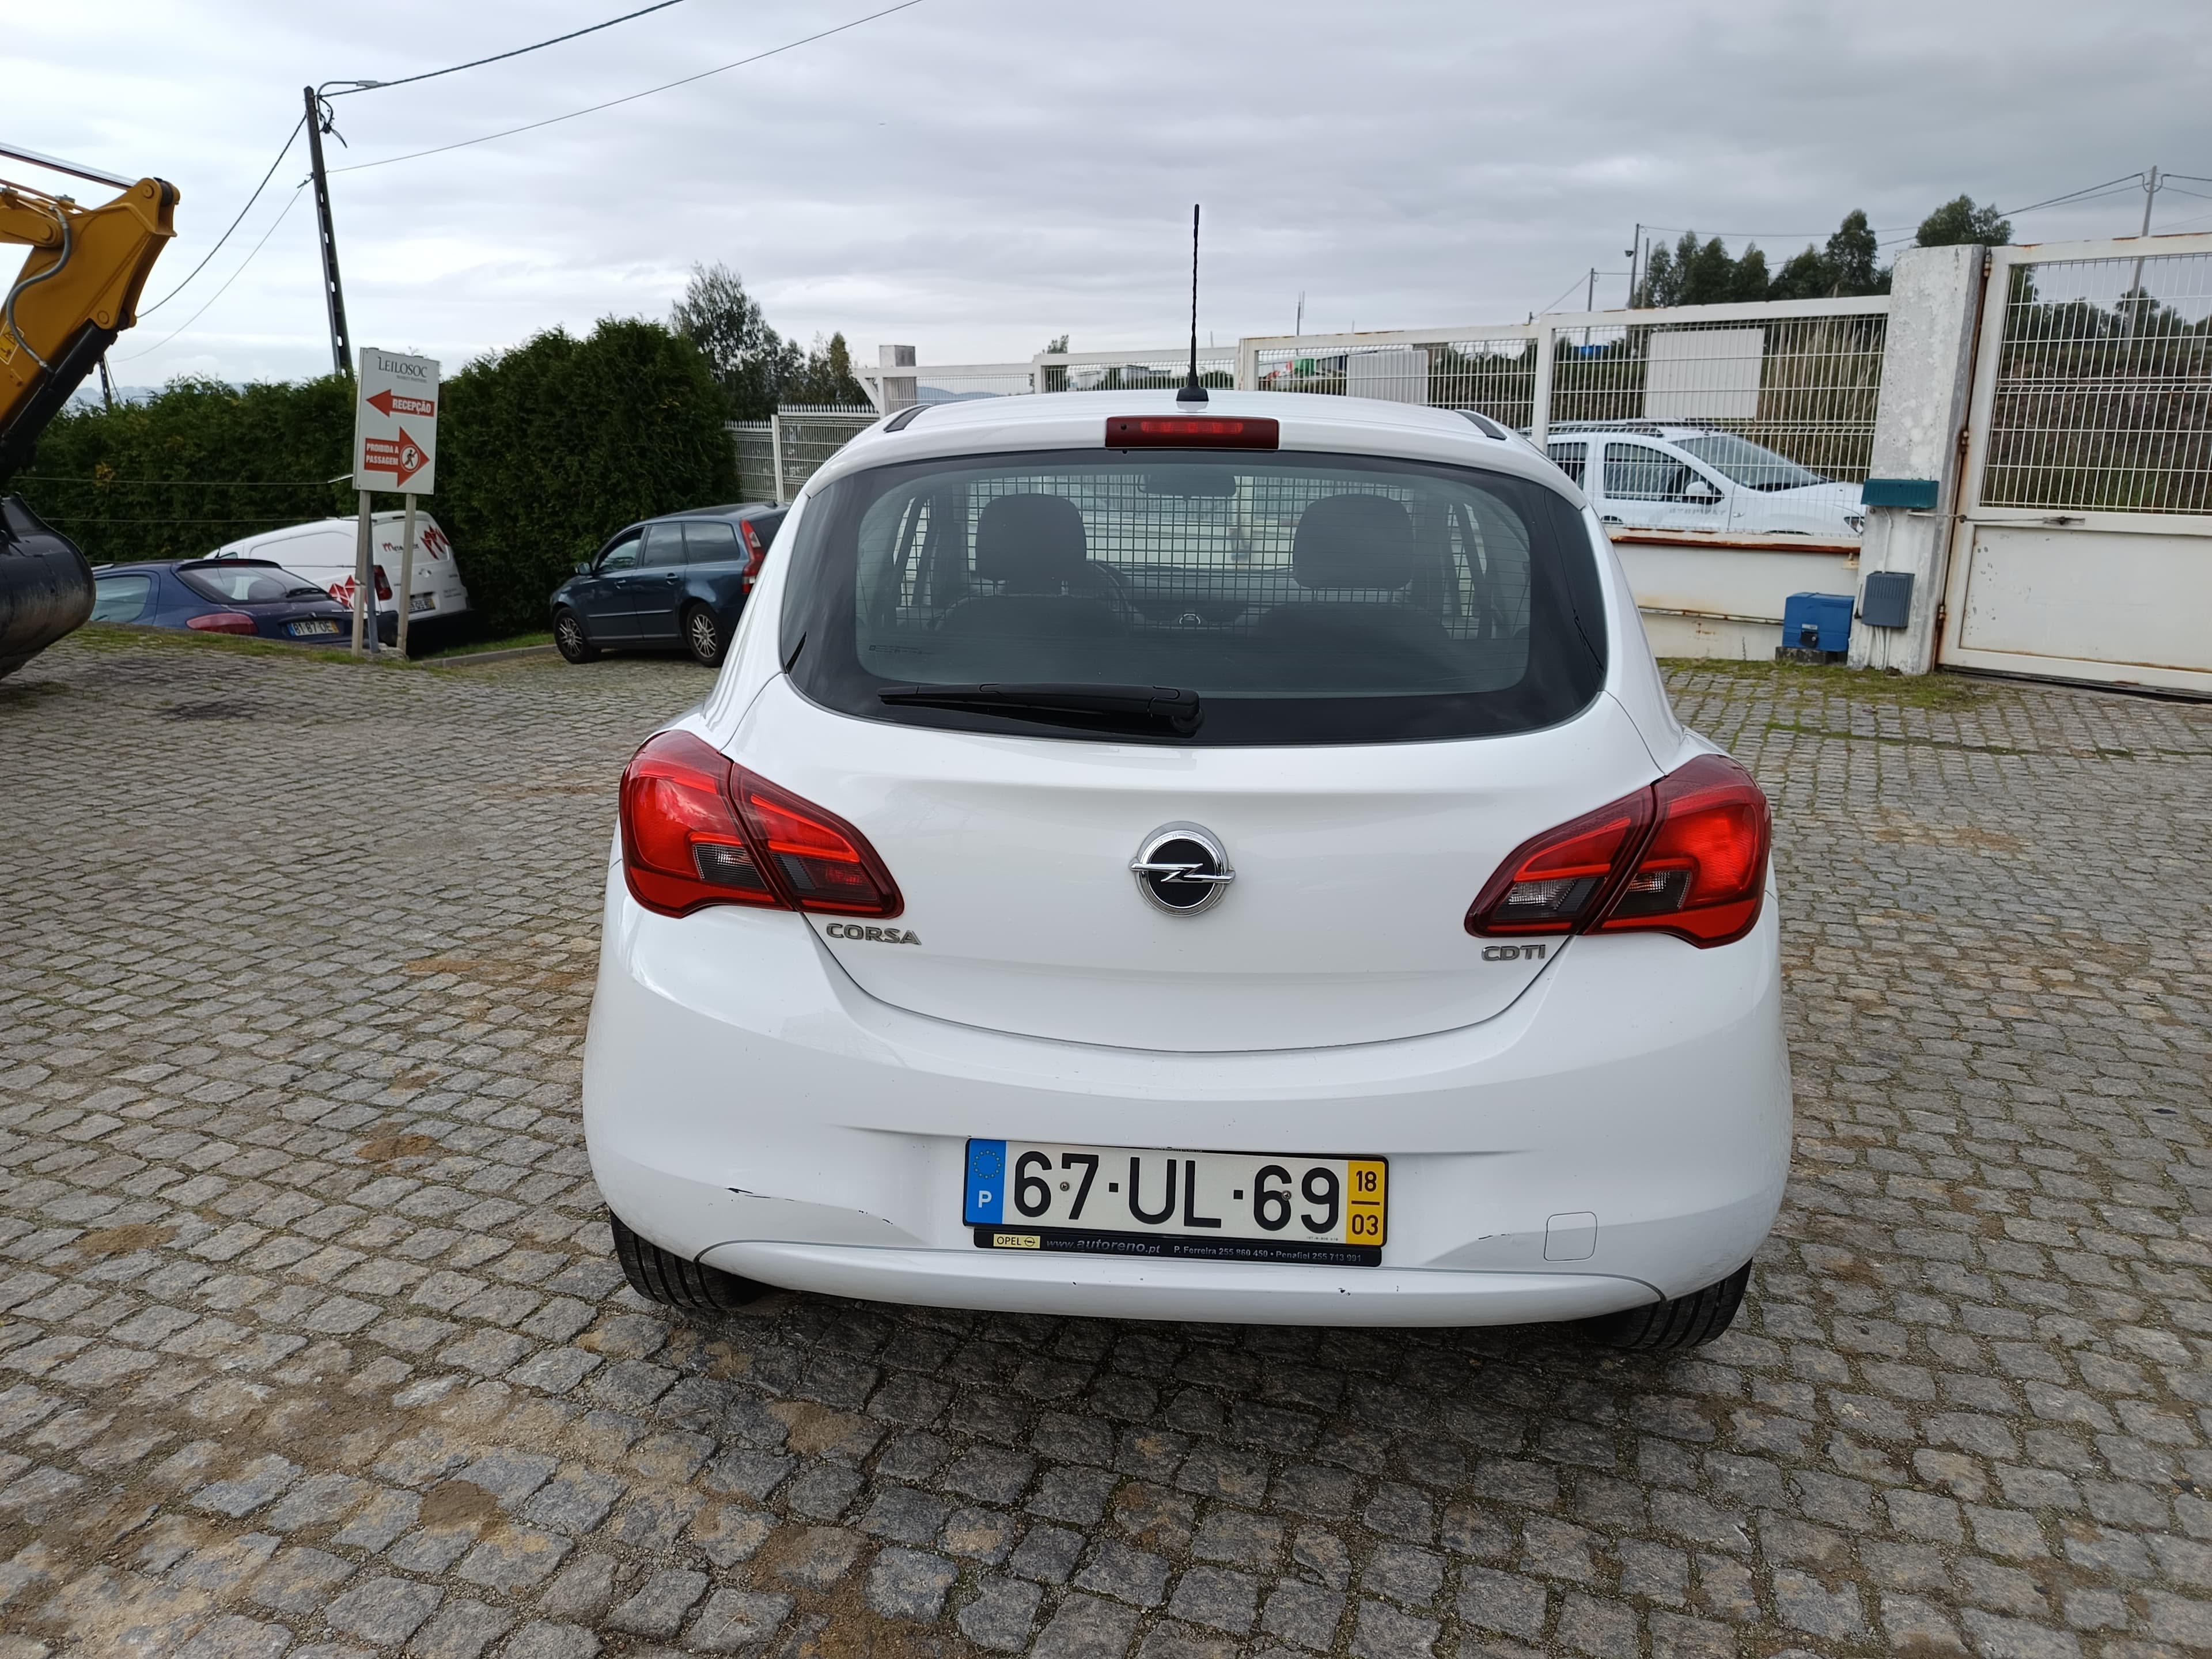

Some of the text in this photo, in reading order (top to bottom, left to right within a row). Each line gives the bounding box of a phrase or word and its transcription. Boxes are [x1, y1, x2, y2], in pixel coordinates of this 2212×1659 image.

[378, 356, 427, 378] LEILOSOC
[392, 398, 431, 415] RECEPÇÃO
[366, 443, 399, 454] PROIBIDA A
[366, 455, 399, 465] PASSAGEM
[826, 923, 922, 945] CORSA
[1481, 945, 1546, 961] CDTI
[1356, 1171, 1377, 1192] 18
[978, 1190, 992, 1209] P
[1351, 1214, 1379, 1236] 03
[996, 1236, 1021, 1245] OPEL
[1046, 1238, 1161, 1253] www.autoreno.pt
[1174, 1245, 1181, 1253] P.
[1183, 1246, 1217, 1255] Ferreira
[1218, 1248, 1234, 1256] 255
[1275, 1251, 1310, 1259] Penafiel
